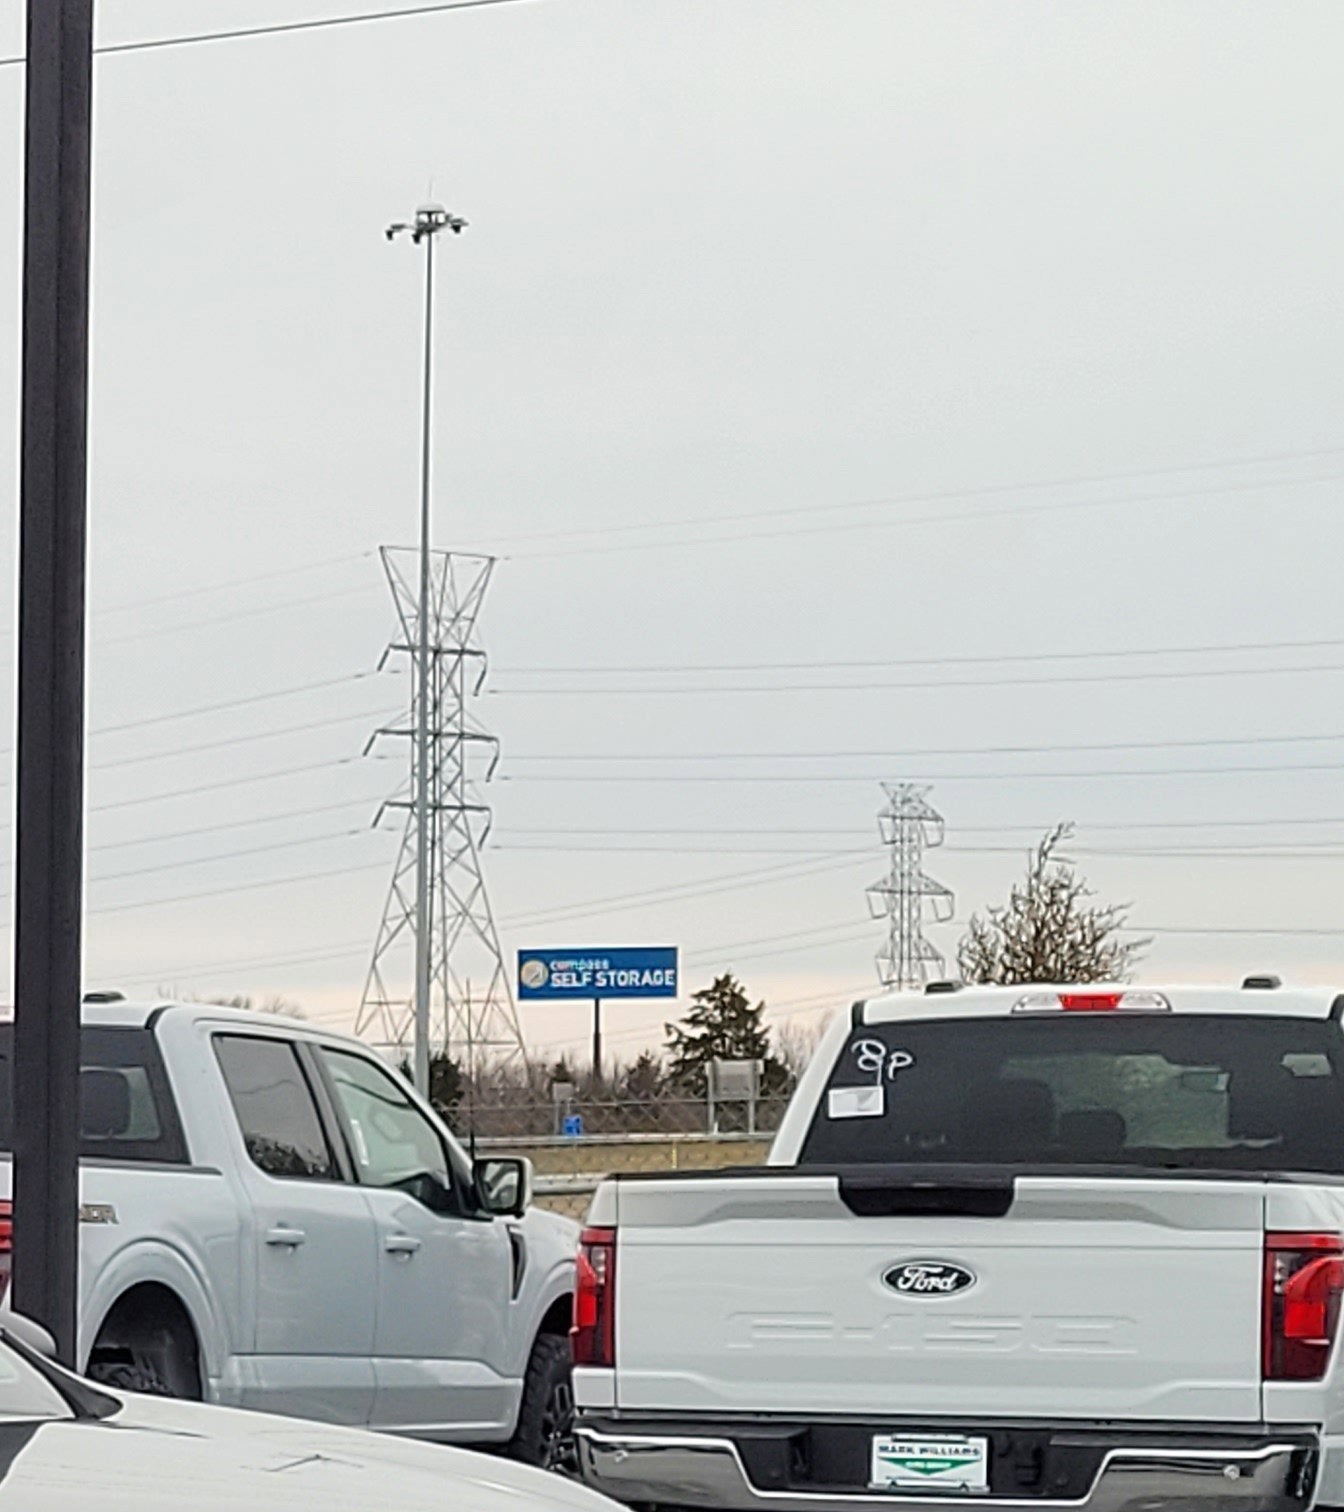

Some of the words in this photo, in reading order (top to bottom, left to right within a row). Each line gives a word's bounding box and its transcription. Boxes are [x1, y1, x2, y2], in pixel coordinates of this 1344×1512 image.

[550, 971, 591, 987] SELF
[595, 969, 676, 987] STORAGE
[896, 1265, 960, 1292] Ford
